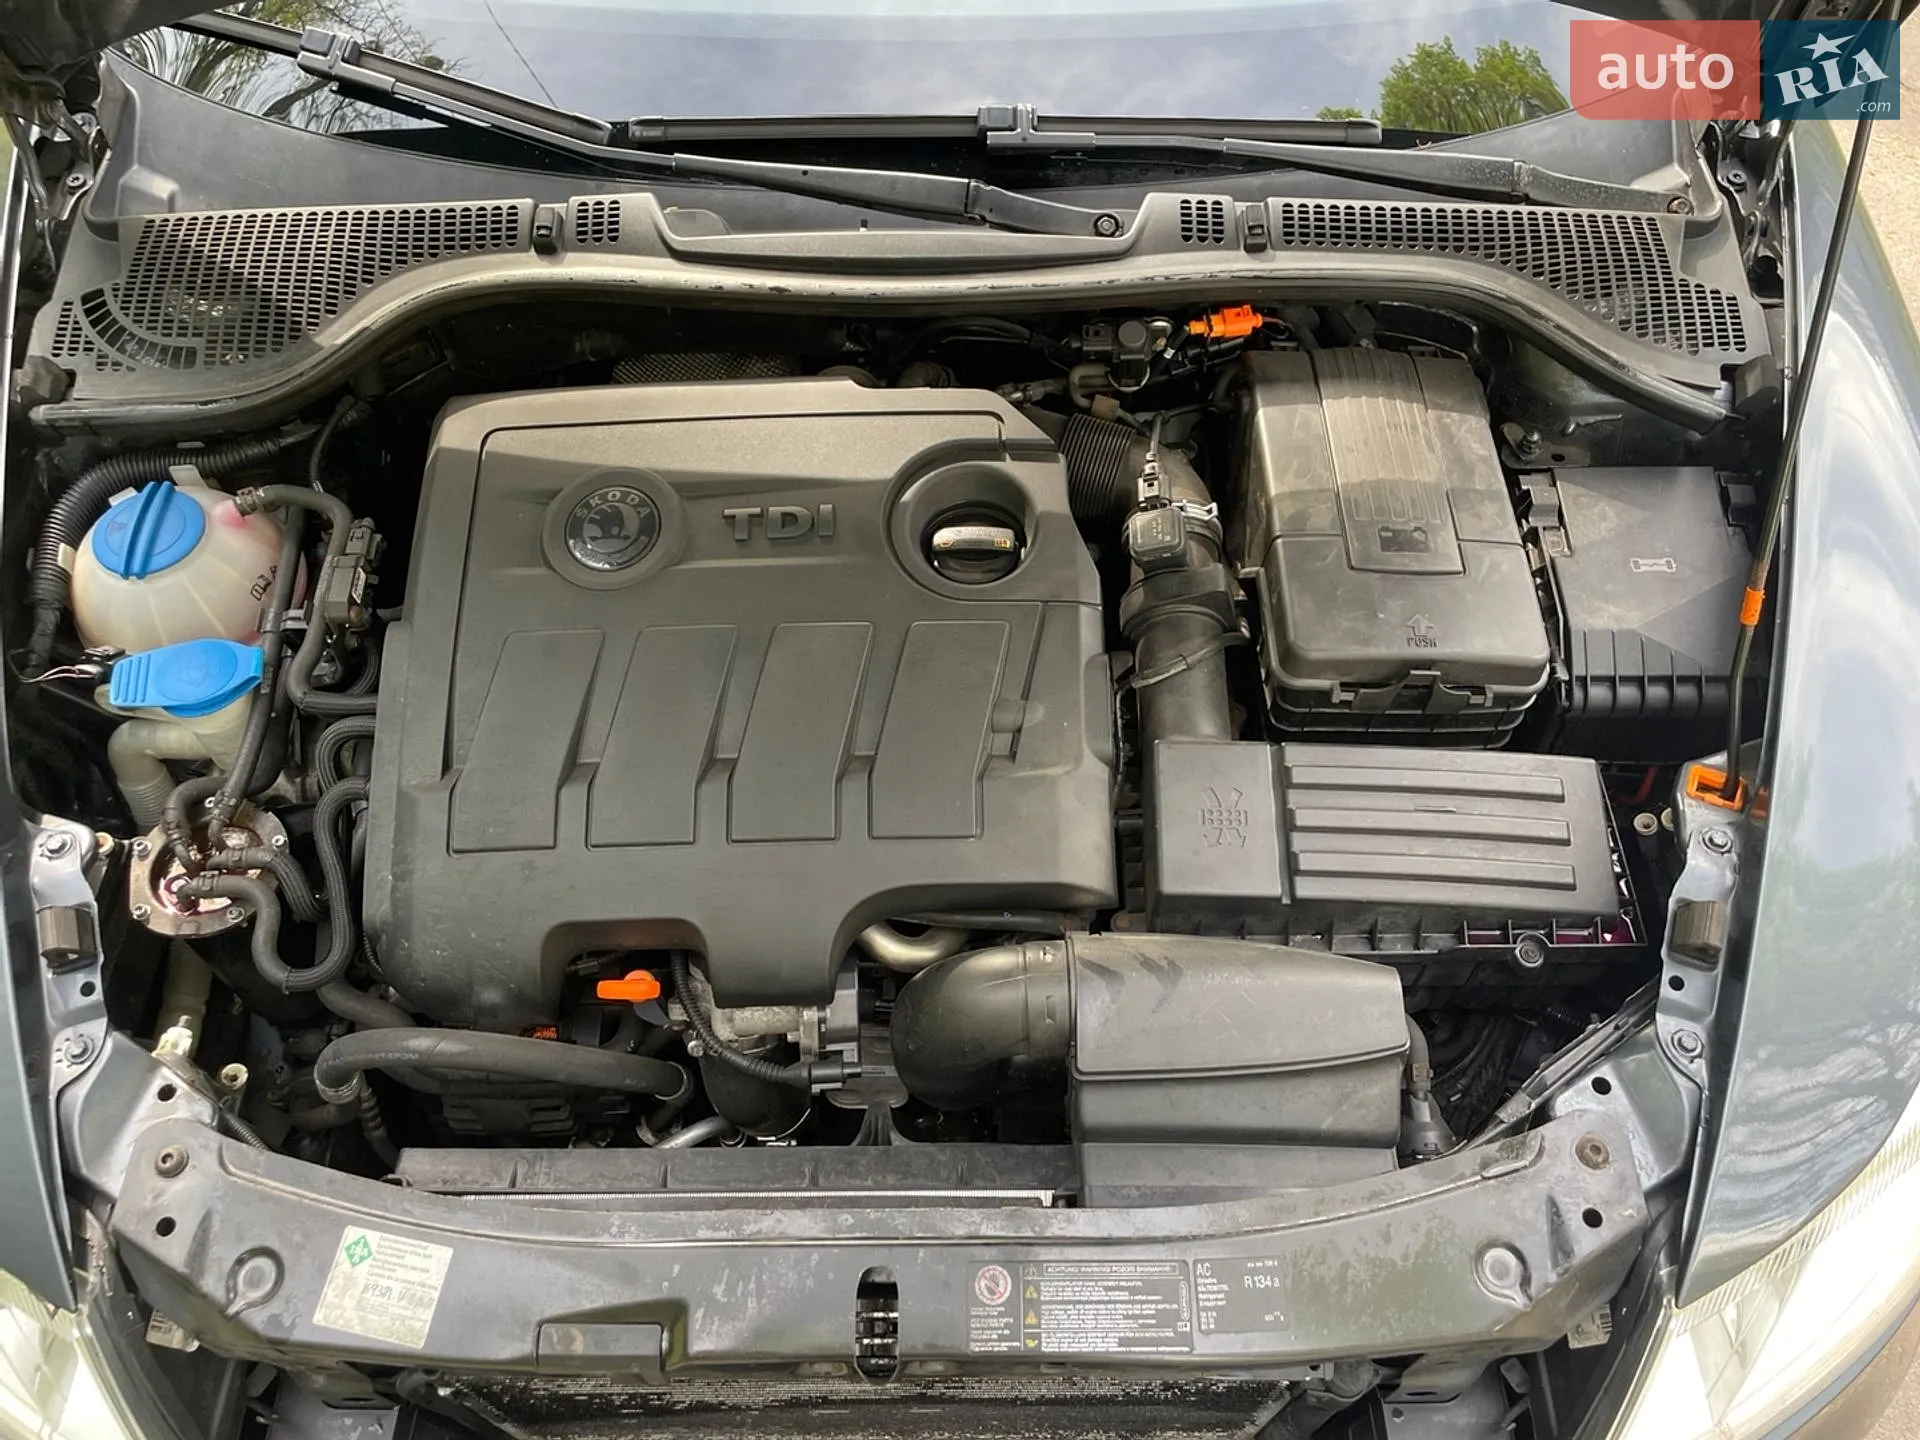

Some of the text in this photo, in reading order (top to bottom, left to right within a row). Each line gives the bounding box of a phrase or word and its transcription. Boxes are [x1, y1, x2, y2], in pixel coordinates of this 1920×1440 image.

[722, 503, 835, 541] TDI
[1406, 637, 1438, 648] PUSH
[1196, 1262, 1212, 1277] AC
